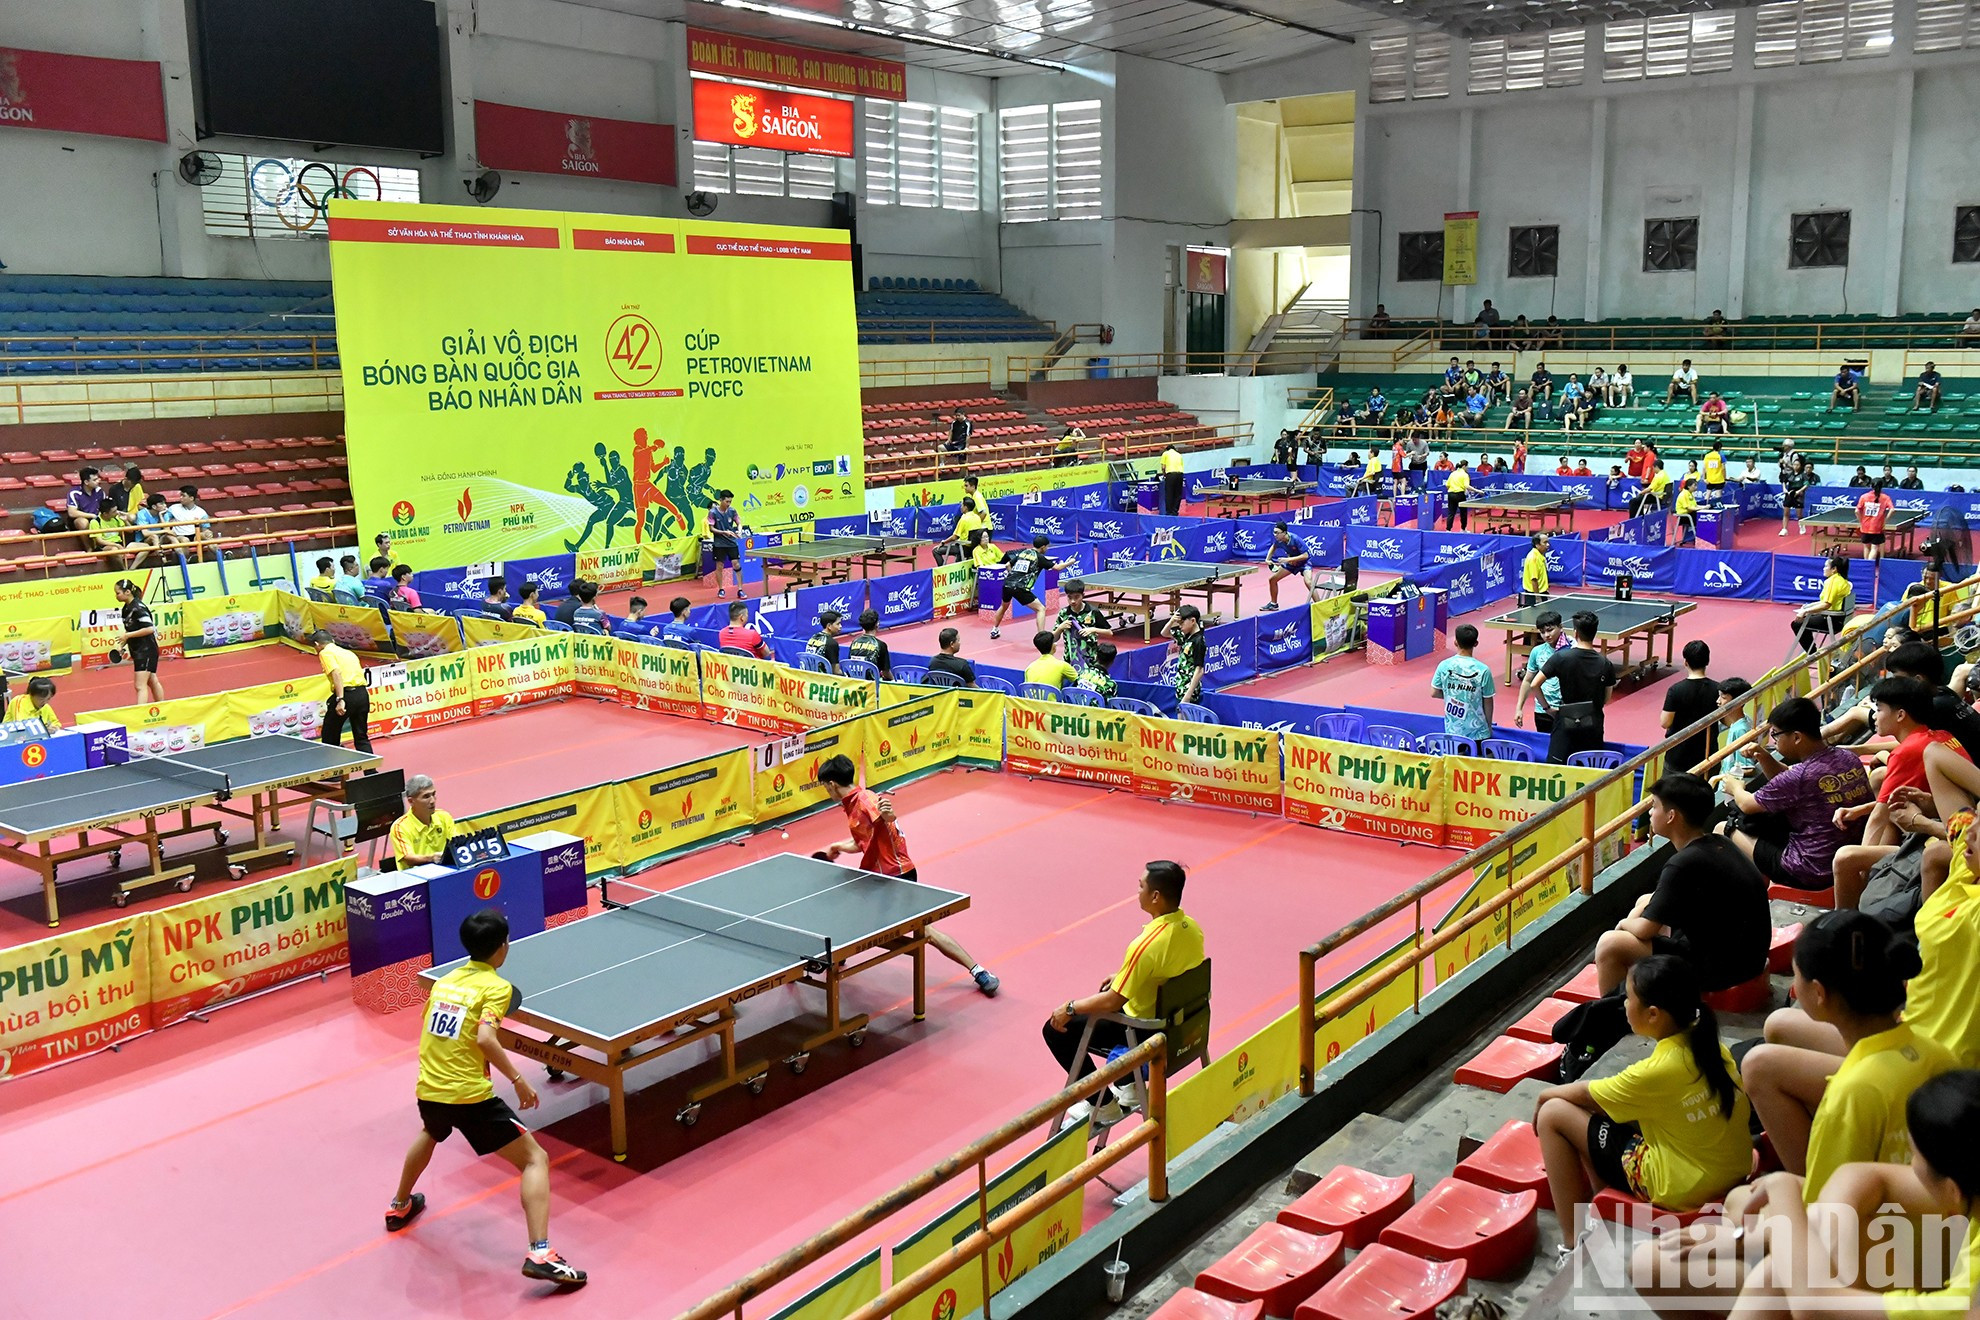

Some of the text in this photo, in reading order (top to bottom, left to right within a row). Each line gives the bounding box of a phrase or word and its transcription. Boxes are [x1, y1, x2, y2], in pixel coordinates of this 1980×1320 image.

[692, 38, 903, 96] ĐOÀN KẾT, TRUNG THỰC, CAO THƯỢNG VÀ TIẾN BỘ
[782, 105, 799, 118] BIA
[561, 159, 599, 172] SAIGON
[415, 228, 428, 237] HÓA
[429, 228, 439, 238] VÀ
[489, 232, 510, 241] KHÁNH
[512, 232, 524, 241] HÒA
[617, 238, 632, 246] NHÂN
[633, 238, 645, 246] DÂN
[441, 328, 578, 358] GIẢI VÔ ĐỊCH
[612, 323, 652, 370] 42
[685, 328, 720, 351] CÚP
[363, 352, 580, 386] BÓNG BÀN QUỐC GIA
[687, 356, 812, 375] PETROVIETNAM
[428, 380, 582, 411] BÁO NHÂN DÂN
[688, 380, 743, 398] PVCFC
[421, 469, 497, 482] NHÀ ĐỒNG HÀNH CHÍNH
[786, 466, 810, 474] VNPT
[988, 488, 1015, 500] VÔ ĐỊCH
[1053, 481, 1066, 490] CÚP
[444, 519, 490, 534] PETROVIETNAM
[503, 514, 534, 527] PHÚ MỸ
[746, 538, 753, 550] 6
[1366, 539, 1378, 548] 双鱼
[1361, 550, 1404, 560] DOUBLE FISH
[1608, 557, 1622, 567] 双鱼
[1602, 566, 1654, 579] DOUBLE FISH
[9, 588, 27, 600] THỂ
[29, 590, 44, 598] THAO
[71, 584, 88, 594] VIỆT
[885, 600, 920, 614] DOUBLE FISH
[89, 610, 97, 626] 0
[1204, 655, 1241, 673] DOUBLE FISH
[382, 669, 406, 679] TÂY NINH
[480, 664, 570, 690] Cho mùa bội thu
[706, 661, 758, 687] NPK PHÚ
[390, 705, 471, 734] 20 TIN DÙNG
[1445, 701, 1466, 719] 009
[1012, 708, 1127, 743] NPK PHÚ MỸ
[27, 744, 40, 759] 8
[1014, 735, 1127, 762] Cho mùa bội thu
[1139, 728, 1268, 763] NPK PHÚ MỸ
[765, 744, 773, 768] 0
[1039, 760, 1131, 785] 20 TIN DÙNG
[1142, 755, 1268, 785] Cho mùa bội thu
[1290, 745, 1432, 791] NPK PHÚ MỸ
[658, 771, 709, 792] NHÀ ĐỒNG HÀNH CHÍNH
[1452, 769, 1566, 803] NPK PHÚ
[1292, 775, 1431, 814] Cho mùa bội thu
[139, 801, 196, 819] MOFIT
[671, 812, 705, 831] PETROVIETNAM
[457, 846, 473, 865] 3
[487, 838, 502, 855] 5
[479, 872, 494, 896] 7
[163, 868, 347, 956] NPK PHÚ MỸ
[381, 902, 427, 920] Double FISH
[0, 927, 134, 1001] PHÚ MỸ
[728, 974, 787, 1006] MOFIT
[48, 979, 134, 1021] bội thu
[430, 1011, 458, 1036] 164
